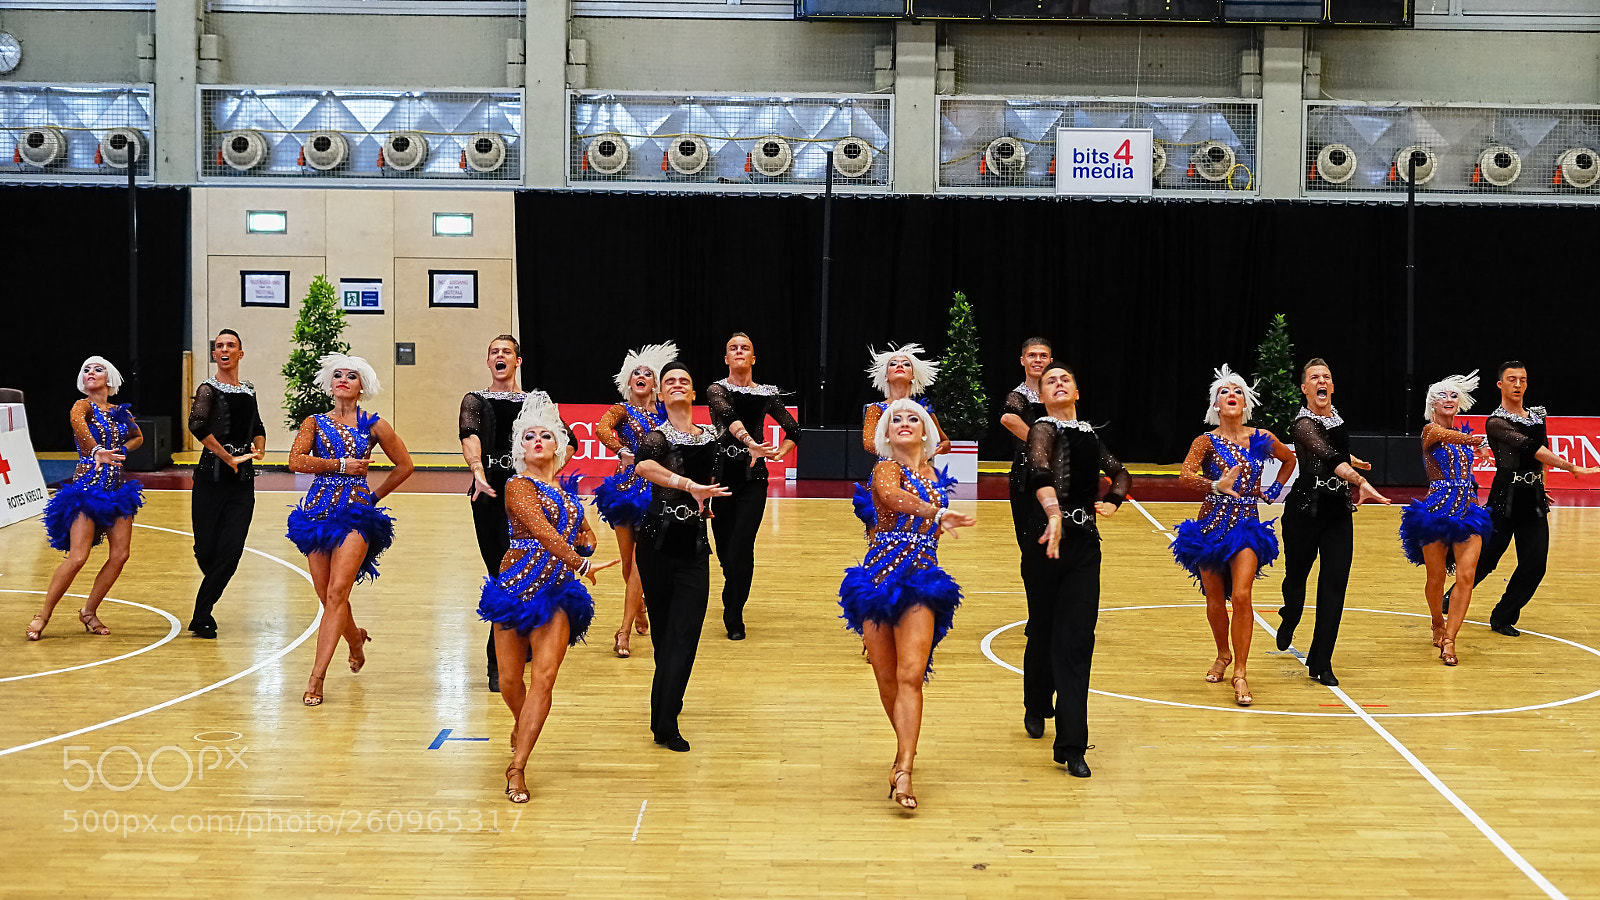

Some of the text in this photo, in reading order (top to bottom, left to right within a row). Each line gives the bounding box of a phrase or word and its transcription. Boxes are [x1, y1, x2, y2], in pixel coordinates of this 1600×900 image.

[1073, 139, 1134, 165] bits 4
[1073, 163, 1134, 179] media
[7, 488, 43, 509] ROTES KREUZ
